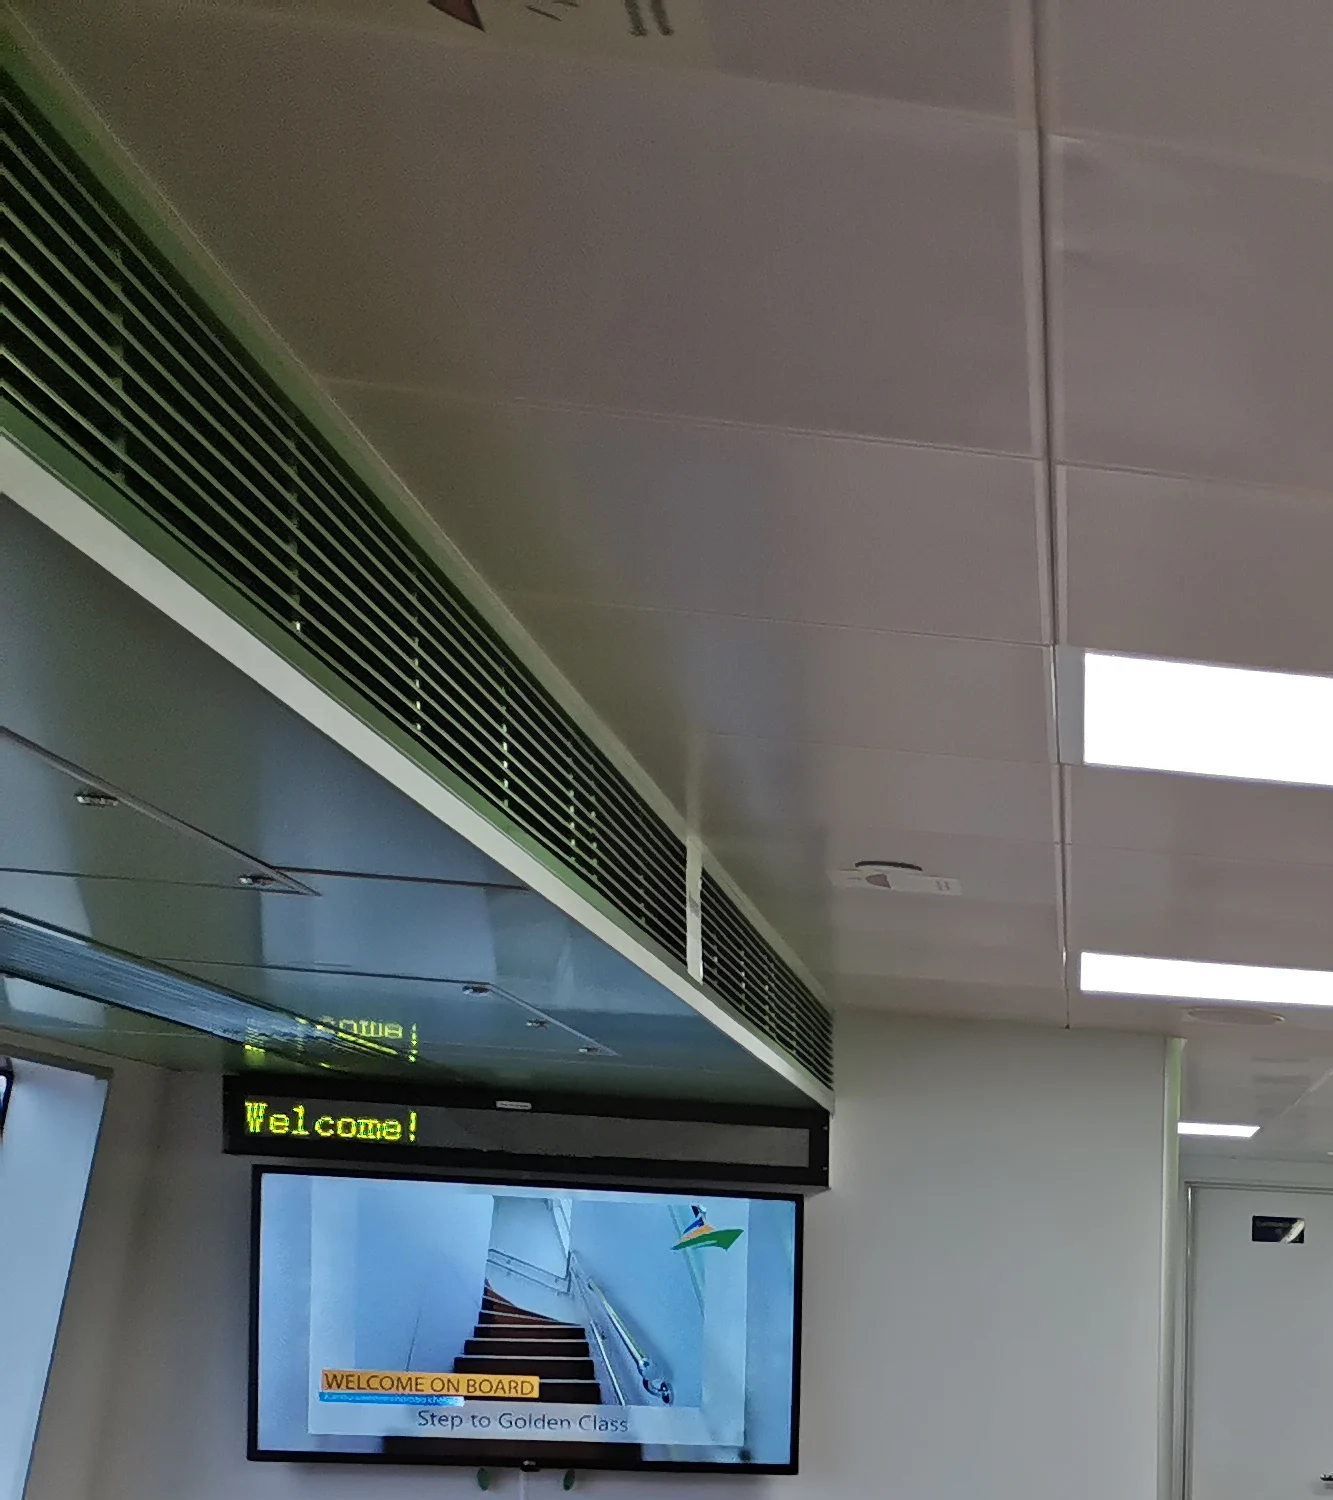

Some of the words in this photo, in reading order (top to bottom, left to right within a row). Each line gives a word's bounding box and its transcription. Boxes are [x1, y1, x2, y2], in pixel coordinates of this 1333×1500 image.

[244, 1101, 418, 1142] Welcome!
[324, 1372, 424, 1393] WELCOME
[430, 1377, 460, 1394] ON
[466, 1378, 535, 1396] BOARD
[417, 1409, 463, 1431] Step
[471, 1412, 491, 1429] to
[499, 1412, 571, 1431] Golden
[578, 1414, 628, 1433] Class
